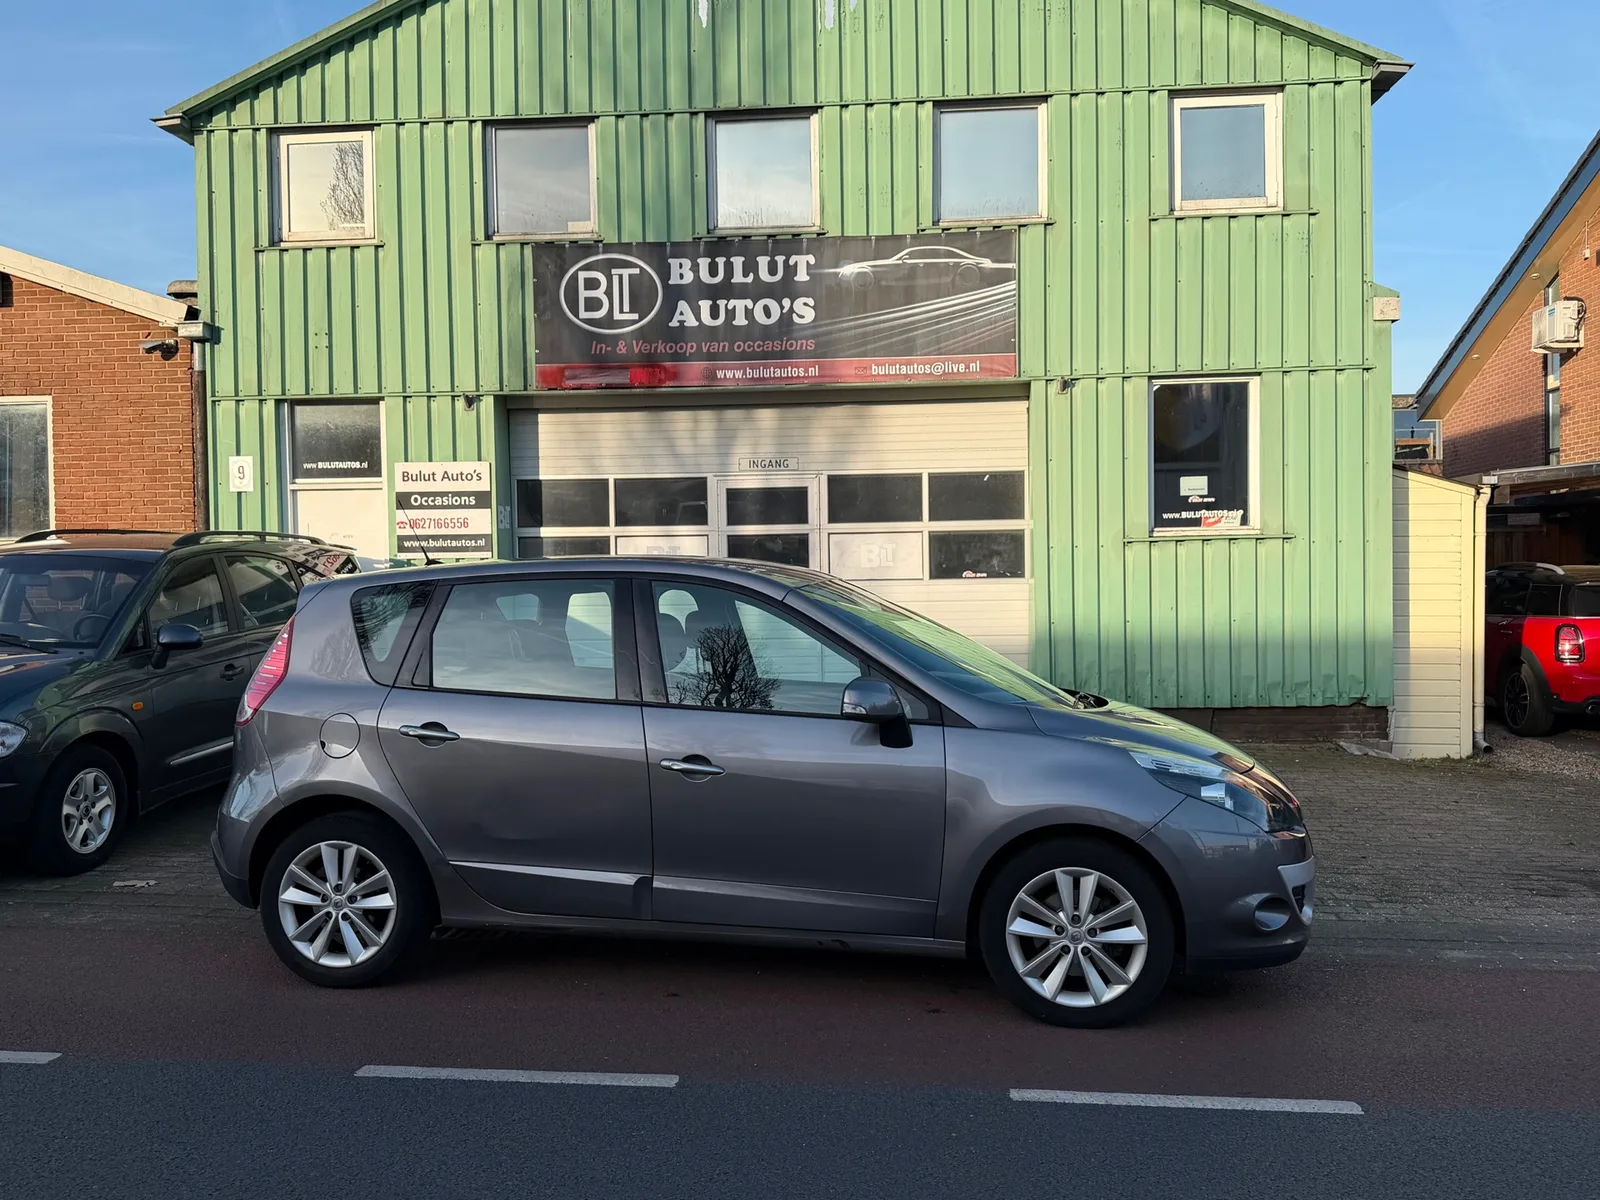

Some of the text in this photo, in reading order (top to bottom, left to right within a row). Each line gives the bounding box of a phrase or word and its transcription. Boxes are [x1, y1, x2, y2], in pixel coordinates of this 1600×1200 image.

[668, 254, 816, 285] BULUT
[668, 297, 816, 328] AUTO'S
[591, 337, 816, 356] In- & Verkoop van occasions
[716, 365, 819, 380] www.bulutautos.nl
[871, 360, 980, 375] bulutautos@live.nl
[748, 459, 790, 469] INGANG
[237, 465, 245, 480] 9
[401, 469, 482, 482] Bulut Auto's
[410, 494, 476, 506] Occasions
[409, 517, 469, 529] 0627166556
[403, 538, 486, 548] www.bulutautos.nl
